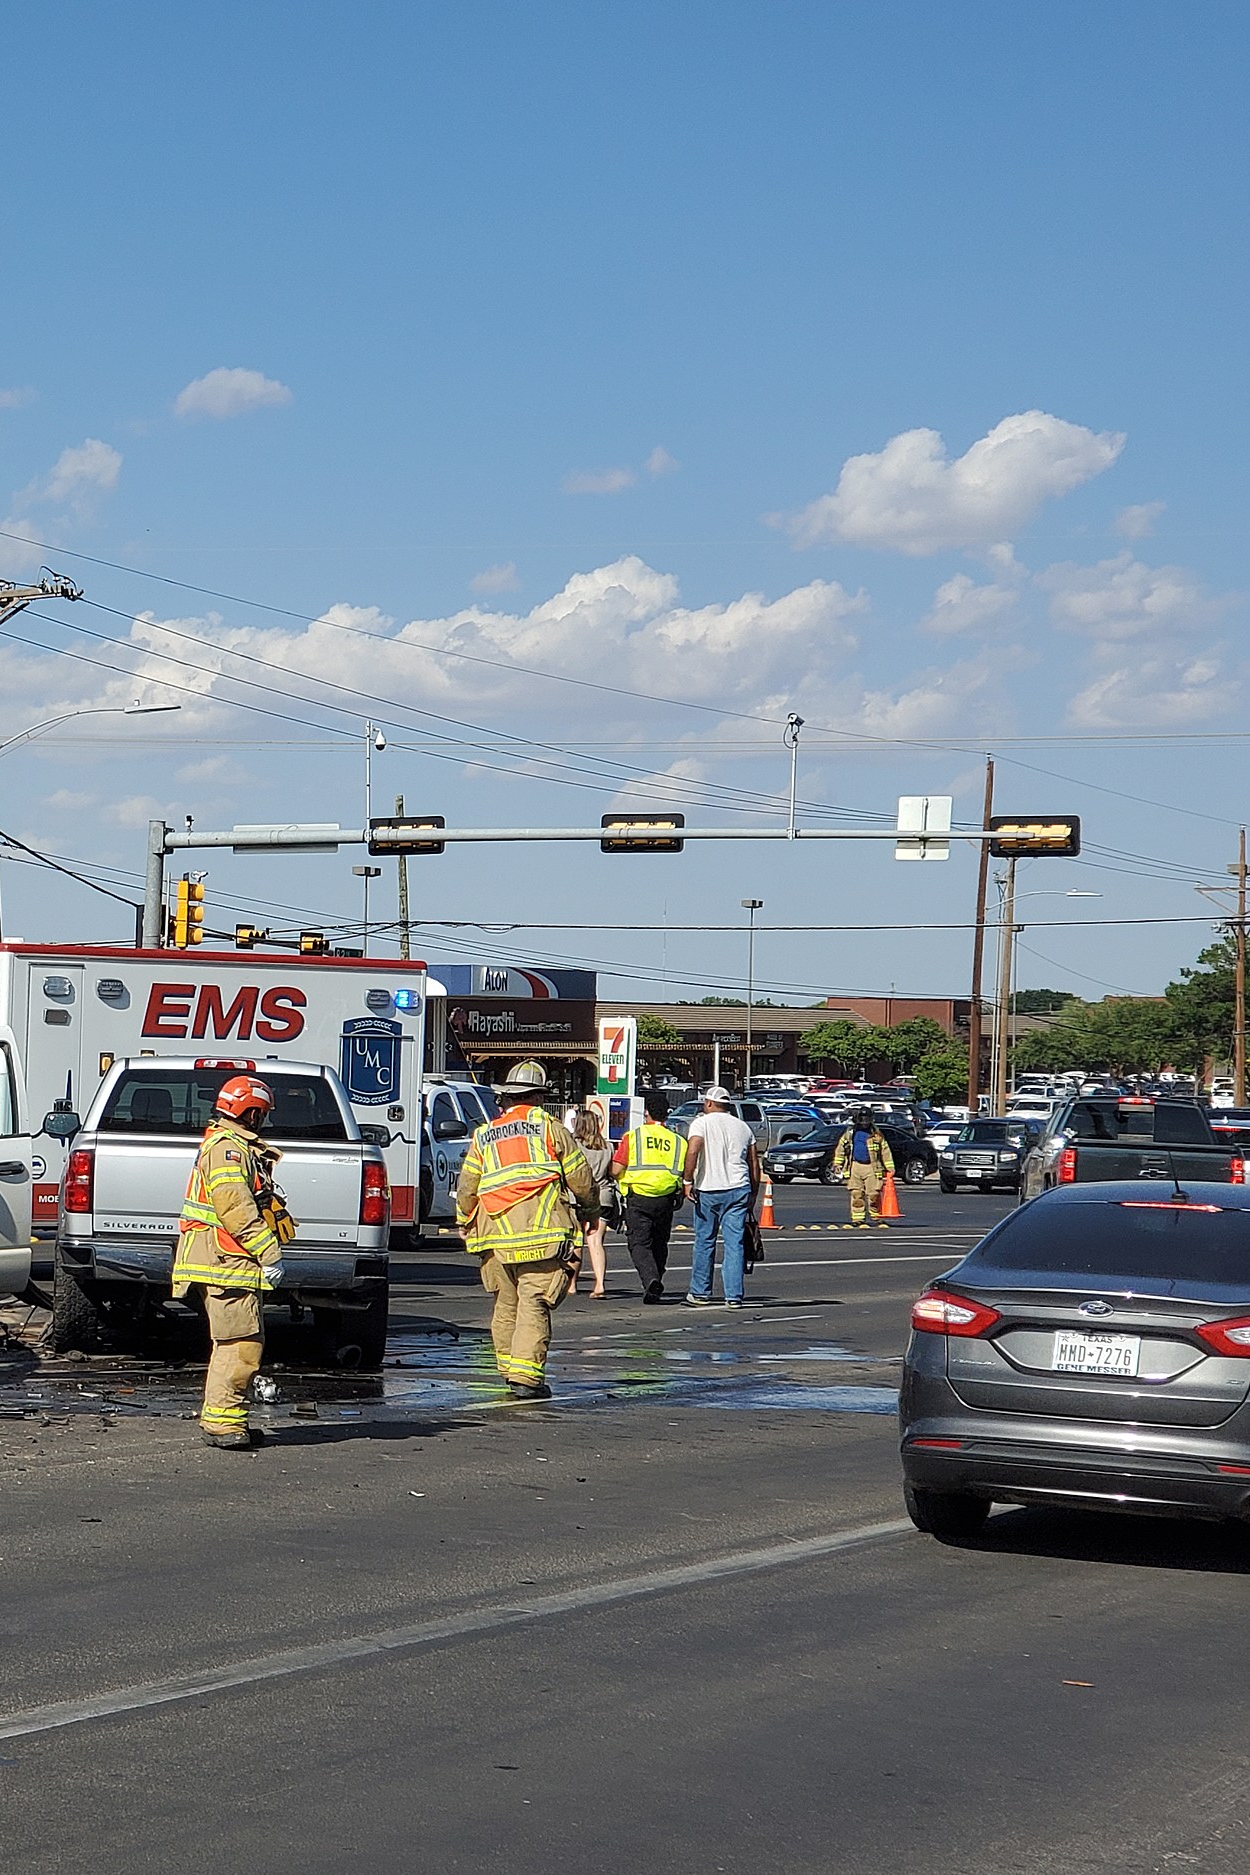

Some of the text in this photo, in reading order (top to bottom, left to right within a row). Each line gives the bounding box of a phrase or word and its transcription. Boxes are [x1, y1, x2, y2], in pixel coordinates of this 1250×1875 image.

[483, 966, 508, 993] ALON
[141, 983, 308, 1043] EMS
[469, 1011, 515, 1036] Hayashi
[646, 1136, 671, 1152] EMS
[103, 1221, 174, 1231] SILVERADO
[514, 1248, 546, 1263] WRIGHT
[1083, 1336, 1113, 1344] TEXAS
[1087, 1365, 1131, 1375] MESSER
